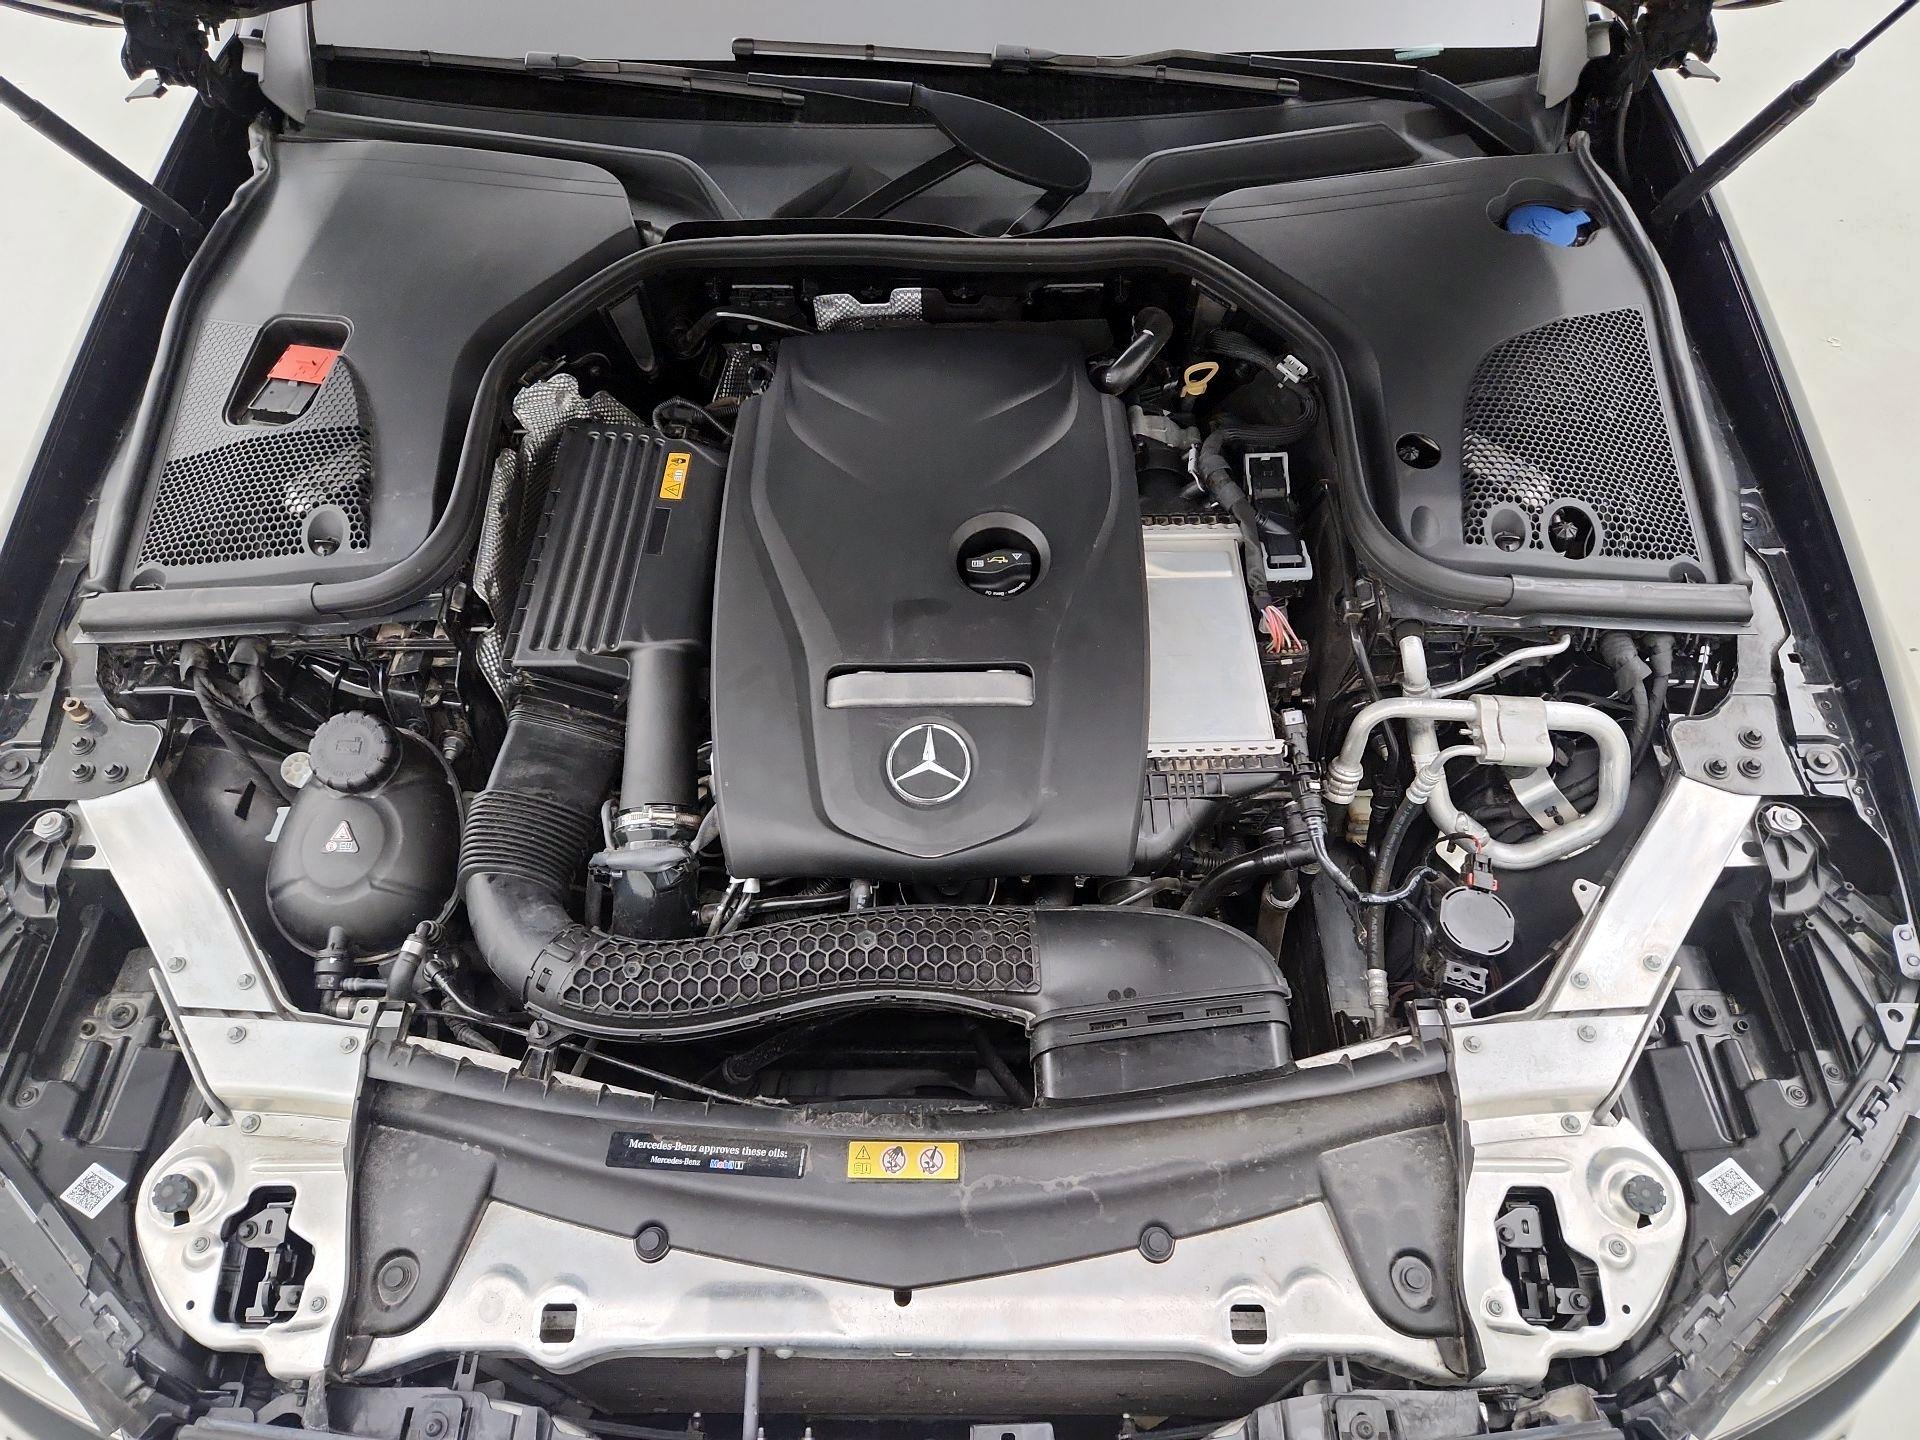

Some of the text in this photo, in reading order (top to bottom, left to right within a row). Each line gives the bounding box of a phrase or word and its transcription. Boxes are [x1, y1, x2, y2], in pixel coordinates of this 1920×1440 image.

[629, 1139, 788, 1158] Mercedes-Benz approves these oils:
[650, 1156, 701, 1166] Mercedes-Benz
